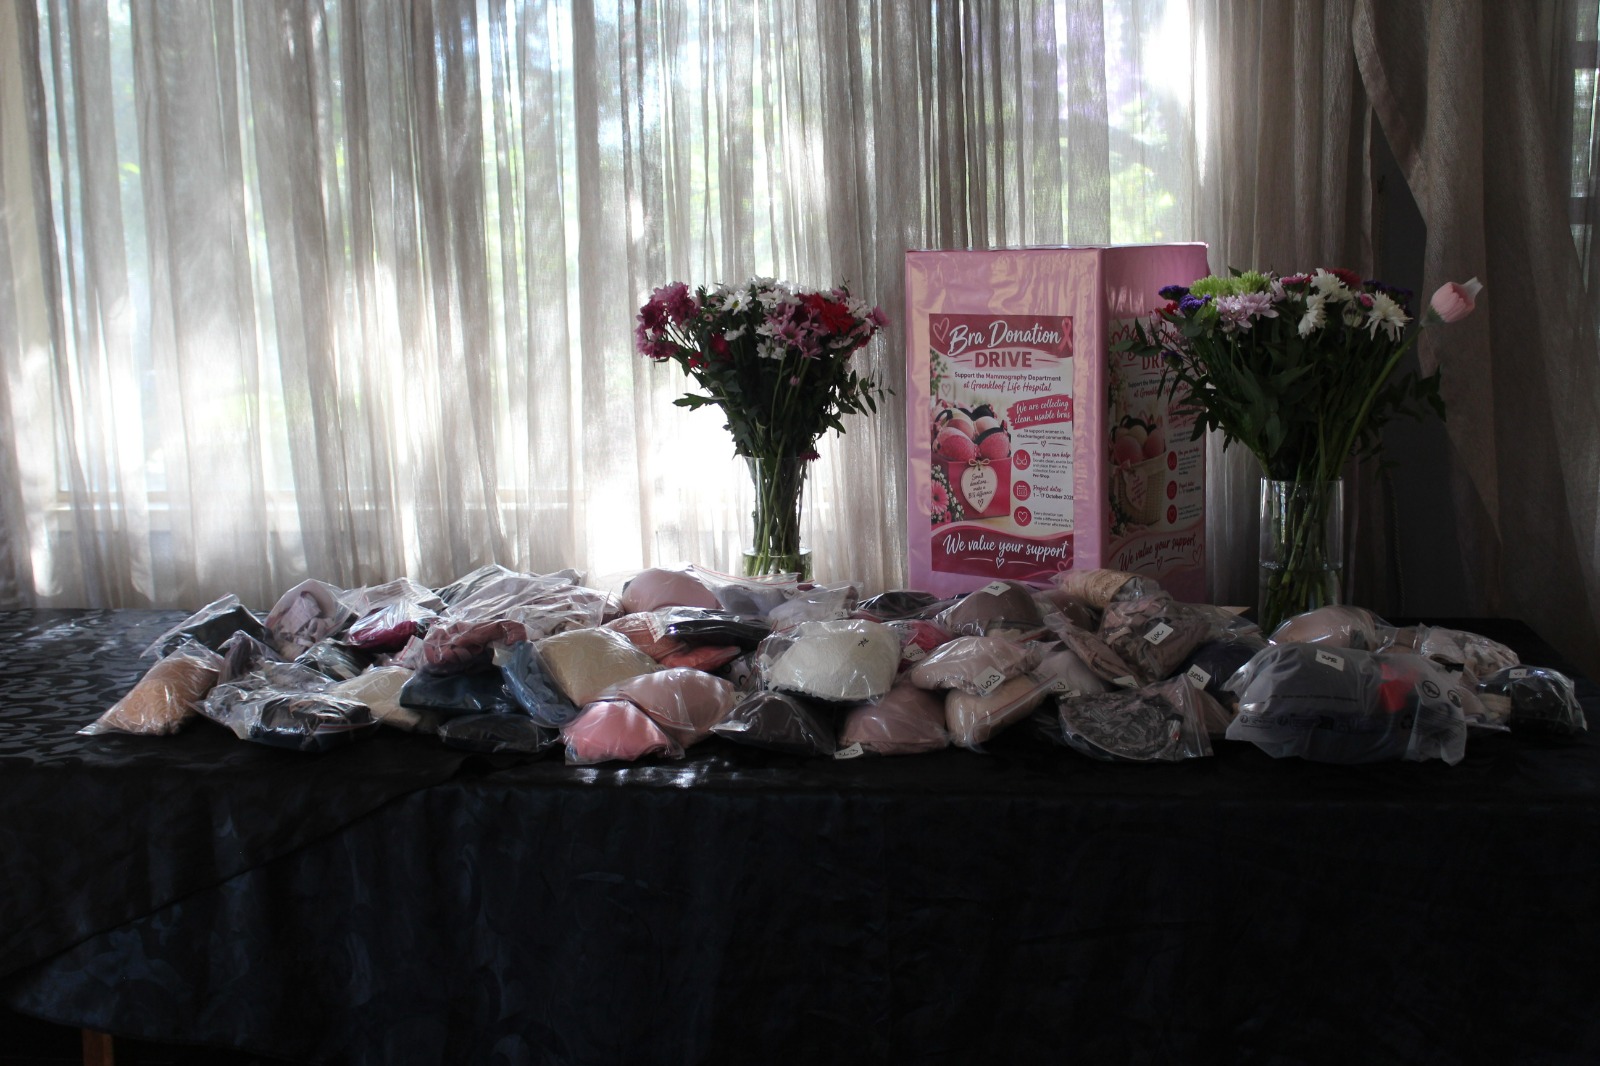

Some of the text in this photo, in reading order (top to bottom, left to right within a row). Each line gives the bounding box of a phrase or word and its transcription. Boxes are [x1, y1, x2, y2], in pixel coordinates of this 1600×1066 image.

[947, 320, 1061, 357] Bra Donation
[975, 351, 1031, 368] DRIVE
[955, 372, 975, 380] Support
[986, 373, 1026, 382] Mammography
[1028, 374, 1061, 382] Department
[963, 380, 1052, 394] at Groenkloof Life Hospital
[1016, 402, 1026, 414] We
[1040, 399, 1069, 411] collecting
[1034, 411, 1055, 421] usable
[943, 533, 1069, 562] We value your support
[1119, 533, 1196, 571] We value your support
